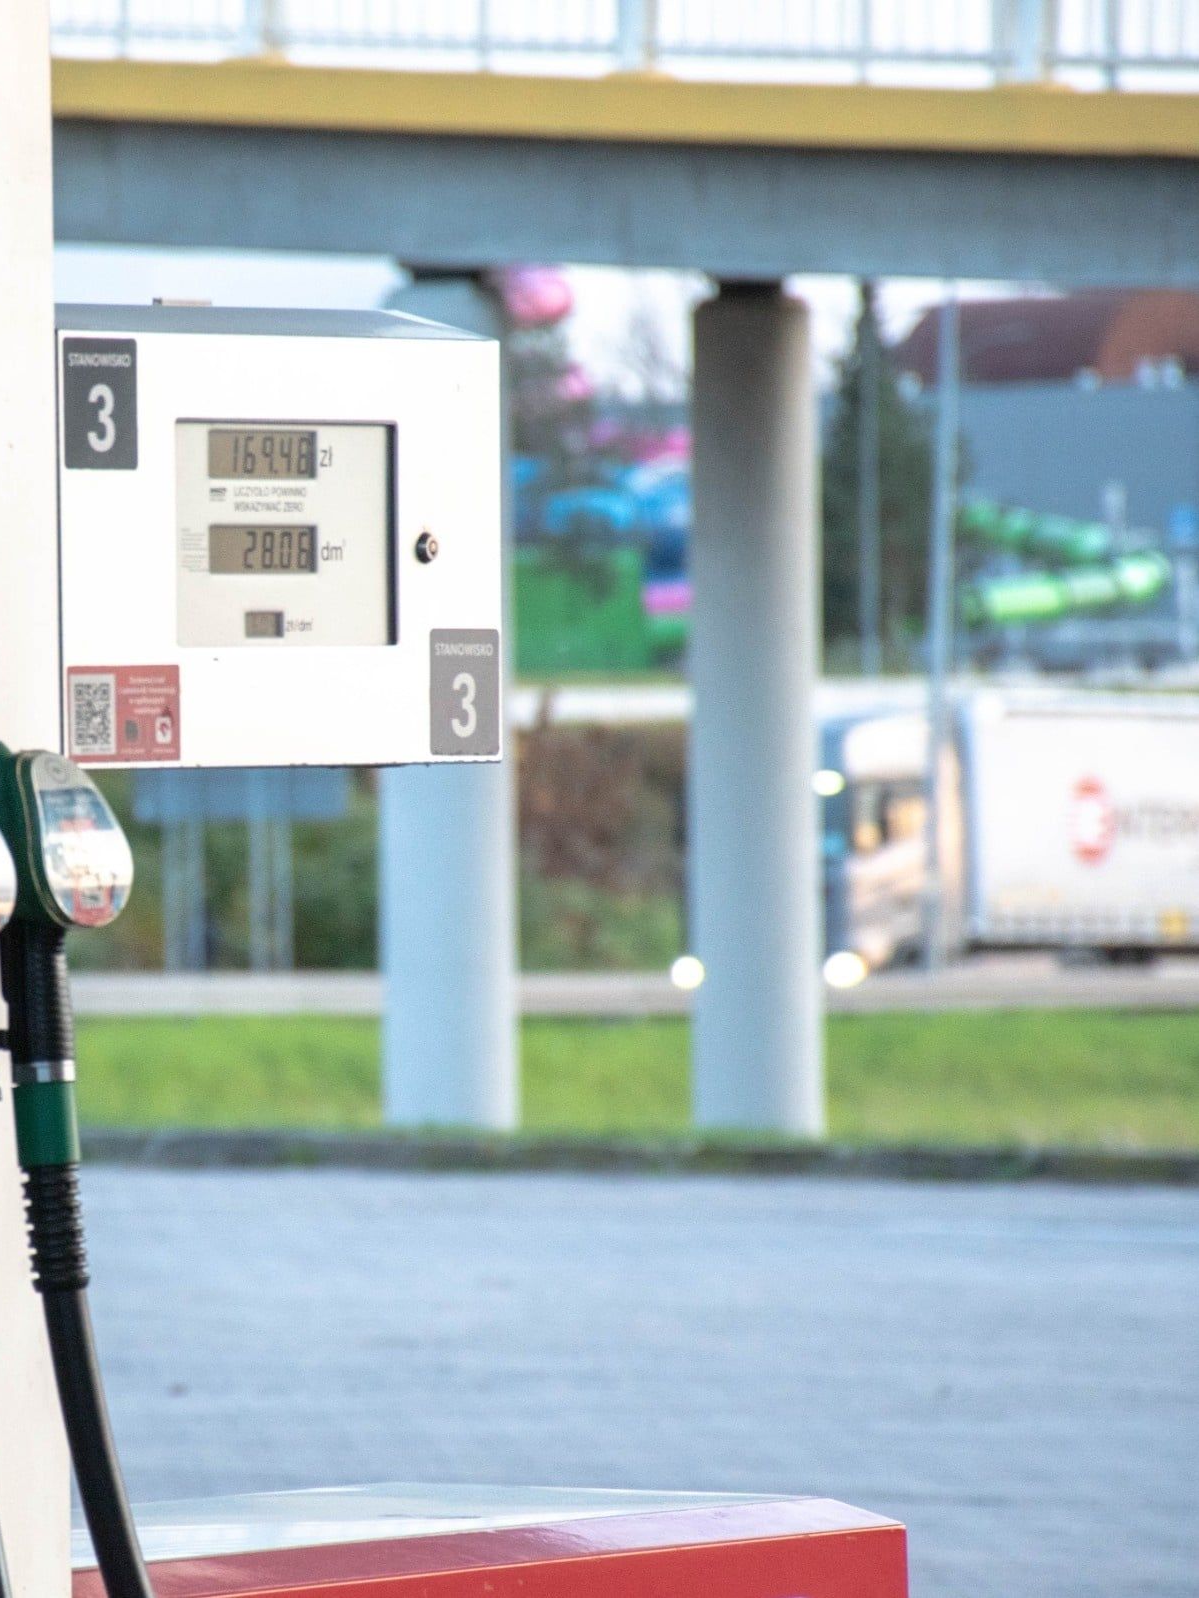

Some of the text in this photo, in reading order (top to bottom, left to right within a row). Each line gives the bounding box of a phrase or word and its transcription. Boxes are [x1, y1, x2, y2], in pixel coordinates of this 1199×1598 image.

[68, 352, 132, 368] STANOWISKO
[87, 383, 116, 453] 3
[434, 643, 494, 657] STANOWISKO
[450, 672, 477, 738] 3
